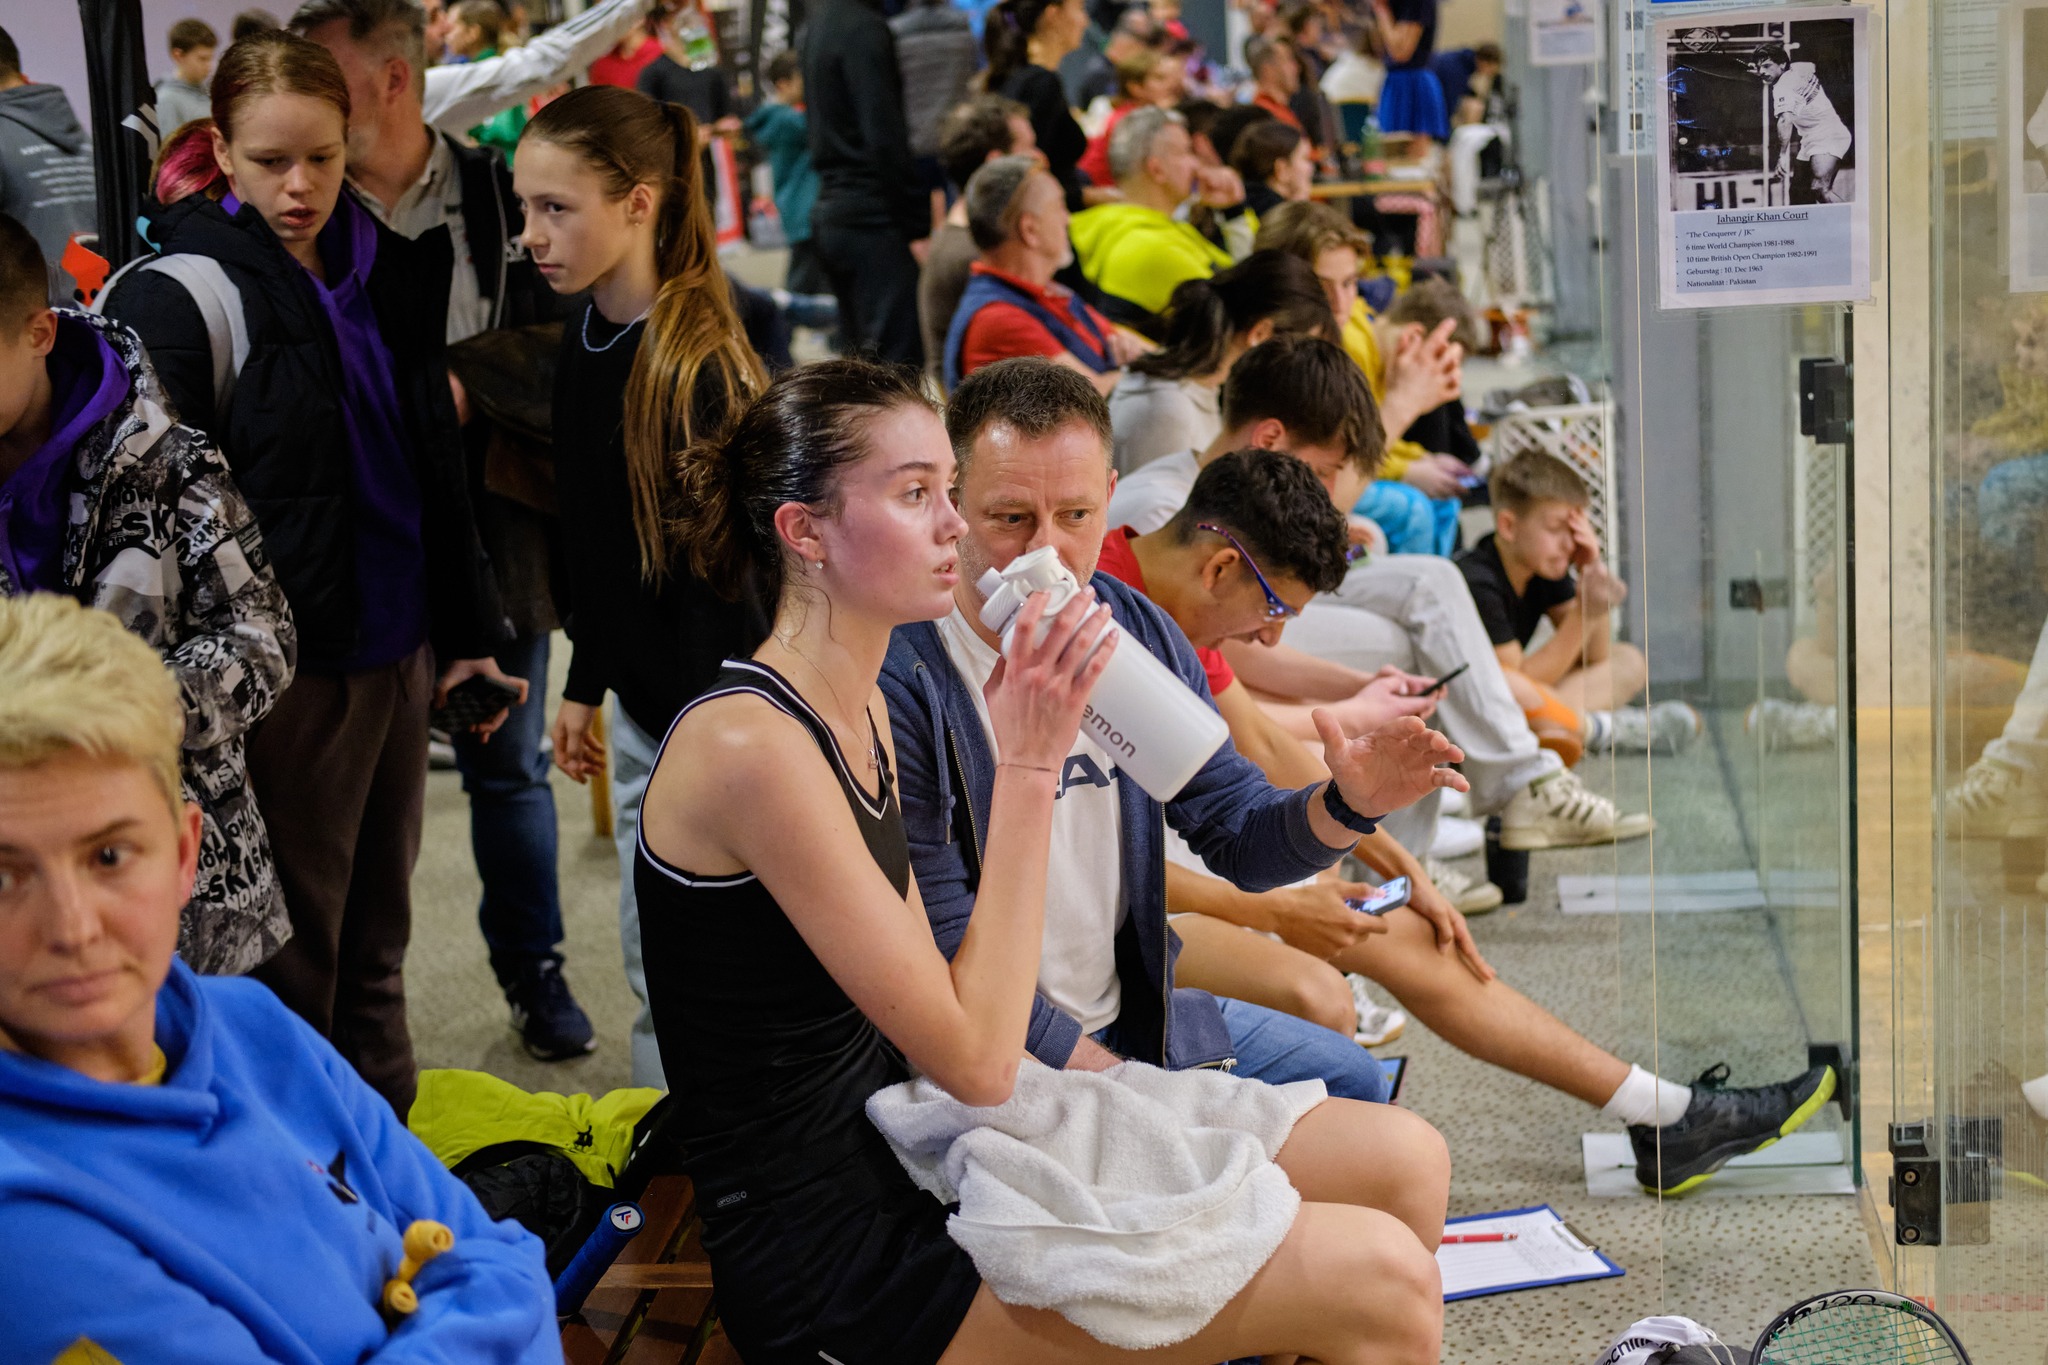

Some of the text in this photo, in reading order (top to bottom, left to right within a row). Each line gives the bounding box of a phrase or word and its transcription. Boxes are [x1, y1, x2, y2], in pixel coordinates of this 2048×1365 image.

[1717, 211, 1809, 225] Jahangir Khan Court
[1703, 229, 1737, 239] Conquerer
[1691, 243, 1706, 251] time
[1707, 242, 1728, 250] World
[1728, 241, 1763, 250] Champion
[1695, 255, 1710, 263] time
[1732, 253, 1751, 262] Open
[1752, 252, 1786, 261] Champion
[1787, 250, 1818, 259] 1982-1991
[1686, 267, 1720, 276] Geburstag
[1724, 266, 1734, 274] 10.
[1748, 265, 1764, 273] 1963
[1686, 280, 1725, 288] Nationalität
[1729, 278, 1757, 286] Pakistan
